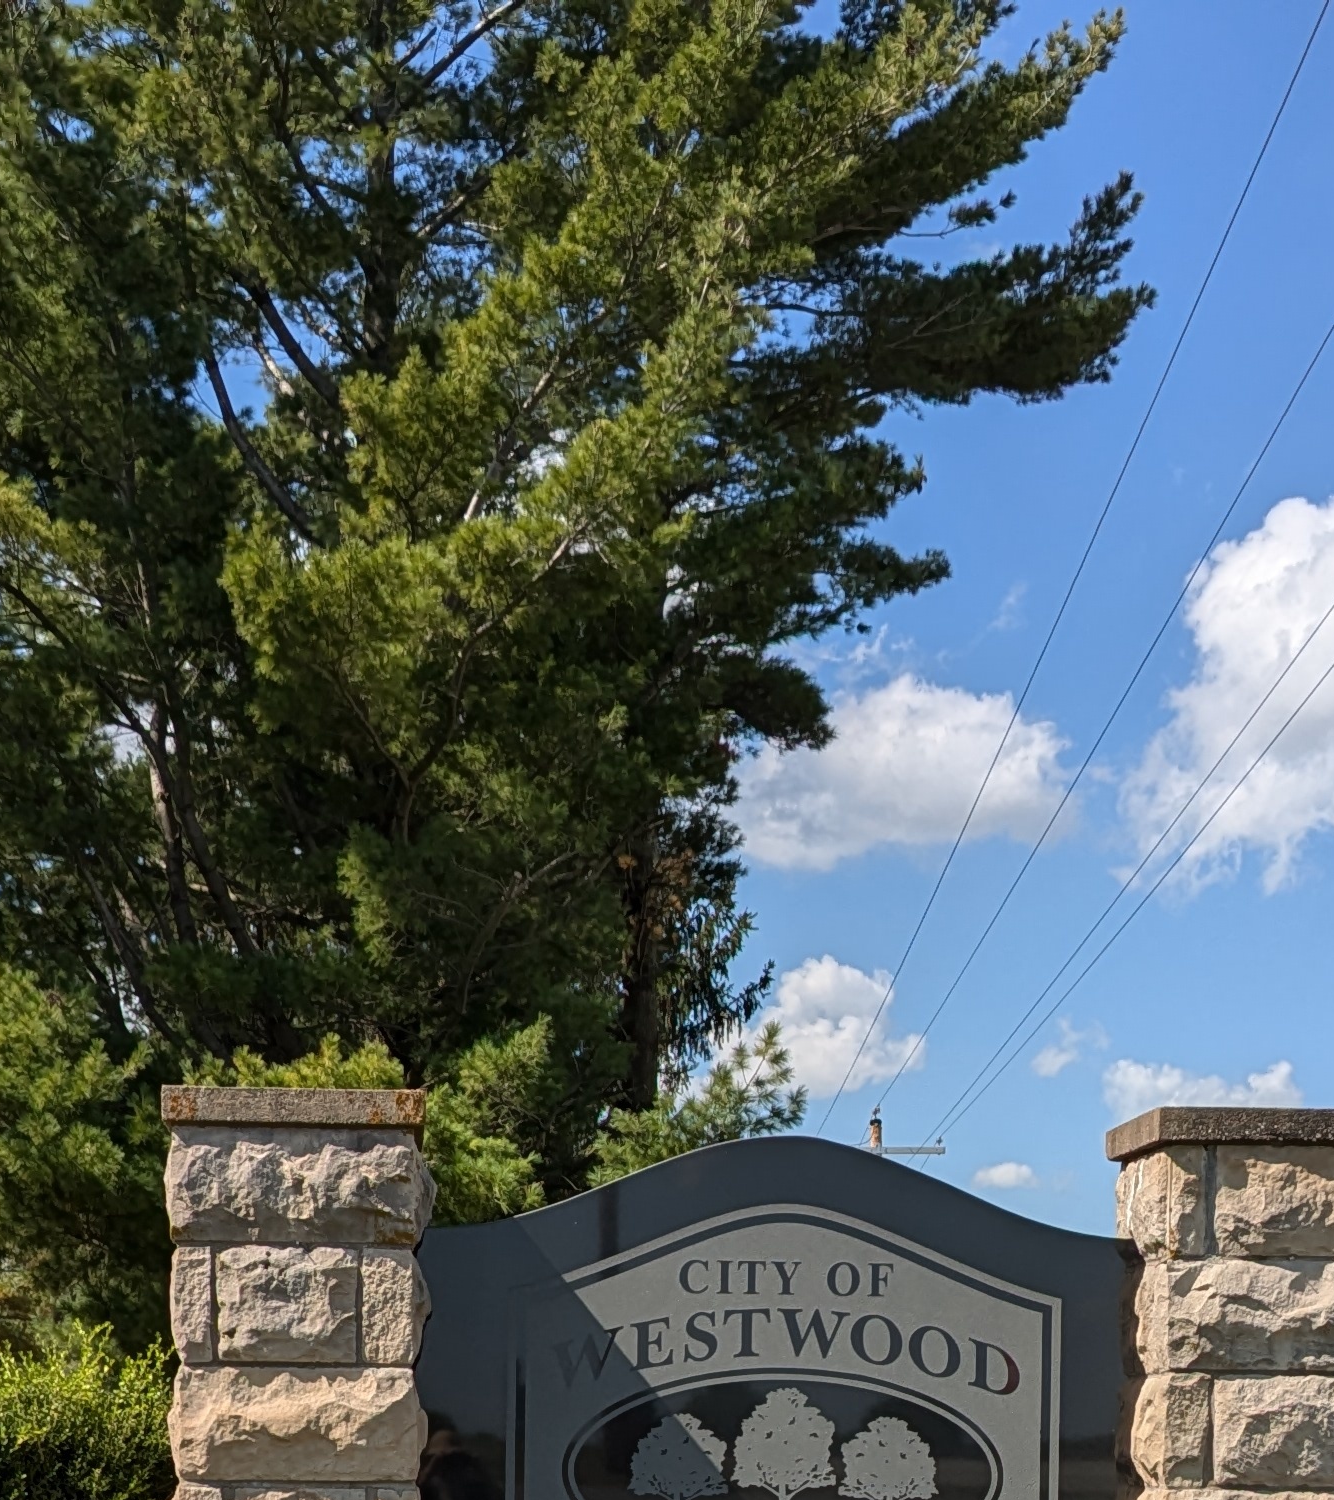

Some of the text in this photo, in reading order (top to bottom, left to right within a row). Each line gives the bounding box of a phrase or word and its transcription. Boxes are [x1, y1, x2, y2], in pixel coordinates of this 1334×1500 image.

[679, 1259, 894, 1297] CITY OF
[551, 1308, 1021, 1395] WESTWOOD
